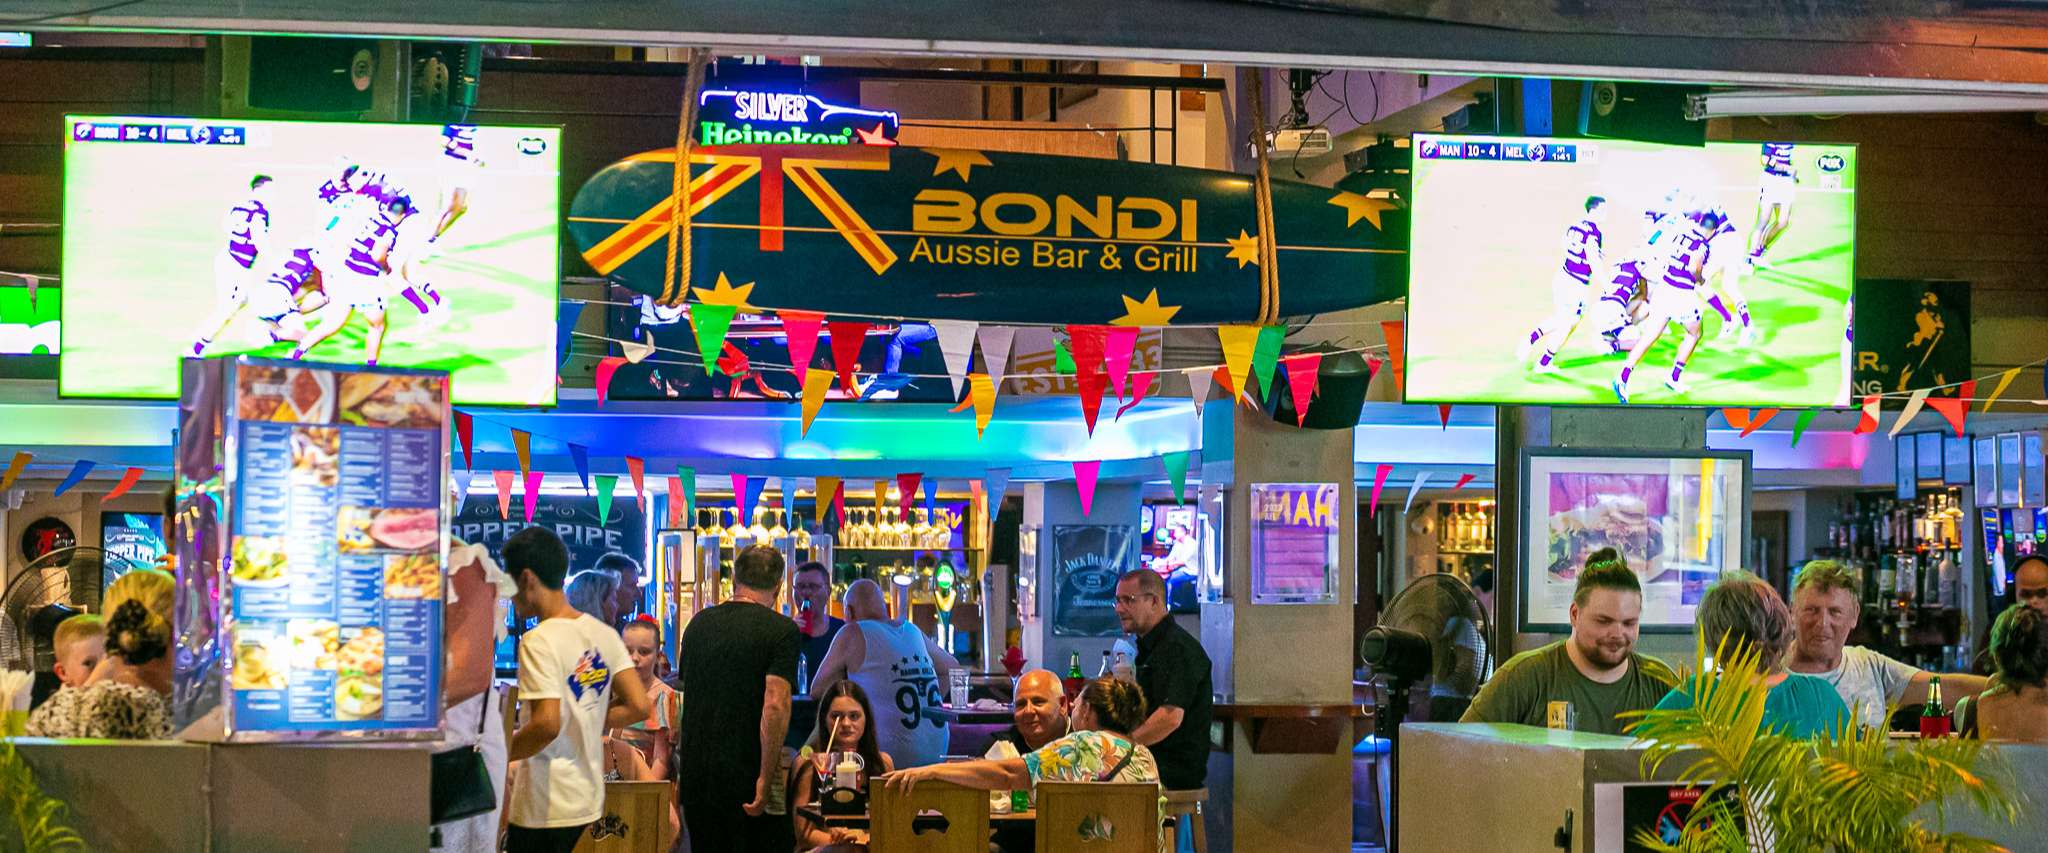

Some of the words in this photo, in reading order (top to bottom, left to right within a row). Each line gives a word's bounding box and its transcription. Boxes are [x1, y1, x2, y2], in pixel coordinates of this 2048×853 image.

[735, 91, 808, 122] SILVER
[1439, 142, 1461, 156] MAN
[1505, 146, 1524, 158] MEL
[913, 189, 1197, 241] BONDI
[909, 237, 1021, 266] Aussie
[1032, 241, 1090, 268] Bar
[1100, 244, 1122, 270] &
[1135, 245, 1197, 273] Grill
[555, 523, 623, 550] PIPE
[1064, 555, 1087, 574] JACK
